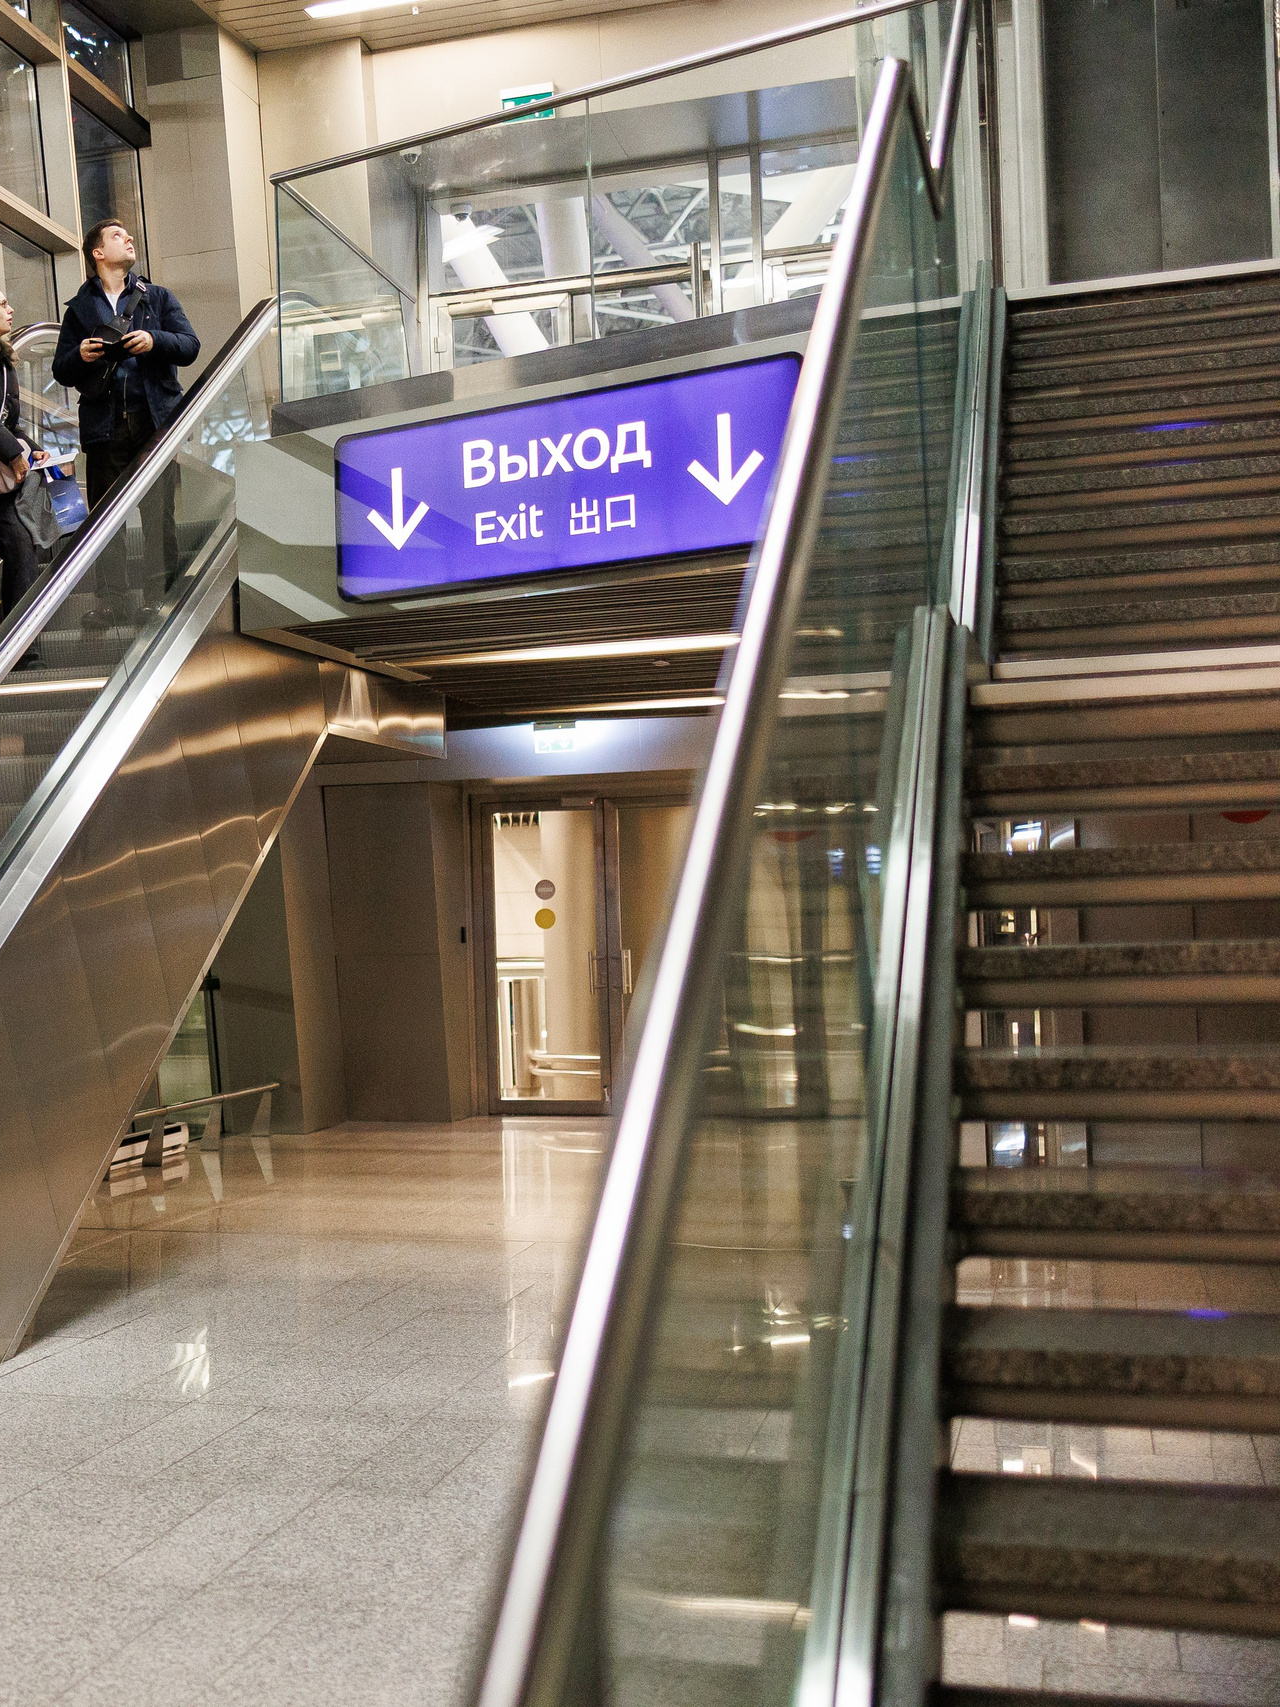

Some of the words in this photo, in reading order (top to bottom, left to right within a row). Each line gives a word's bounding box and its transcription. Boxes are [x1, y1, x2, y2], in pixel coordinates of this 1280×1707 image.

[462, 420, 652, 489] Выход
[474, 502, 544, 546] Exit
[568, 493, 637, 536] 出口
